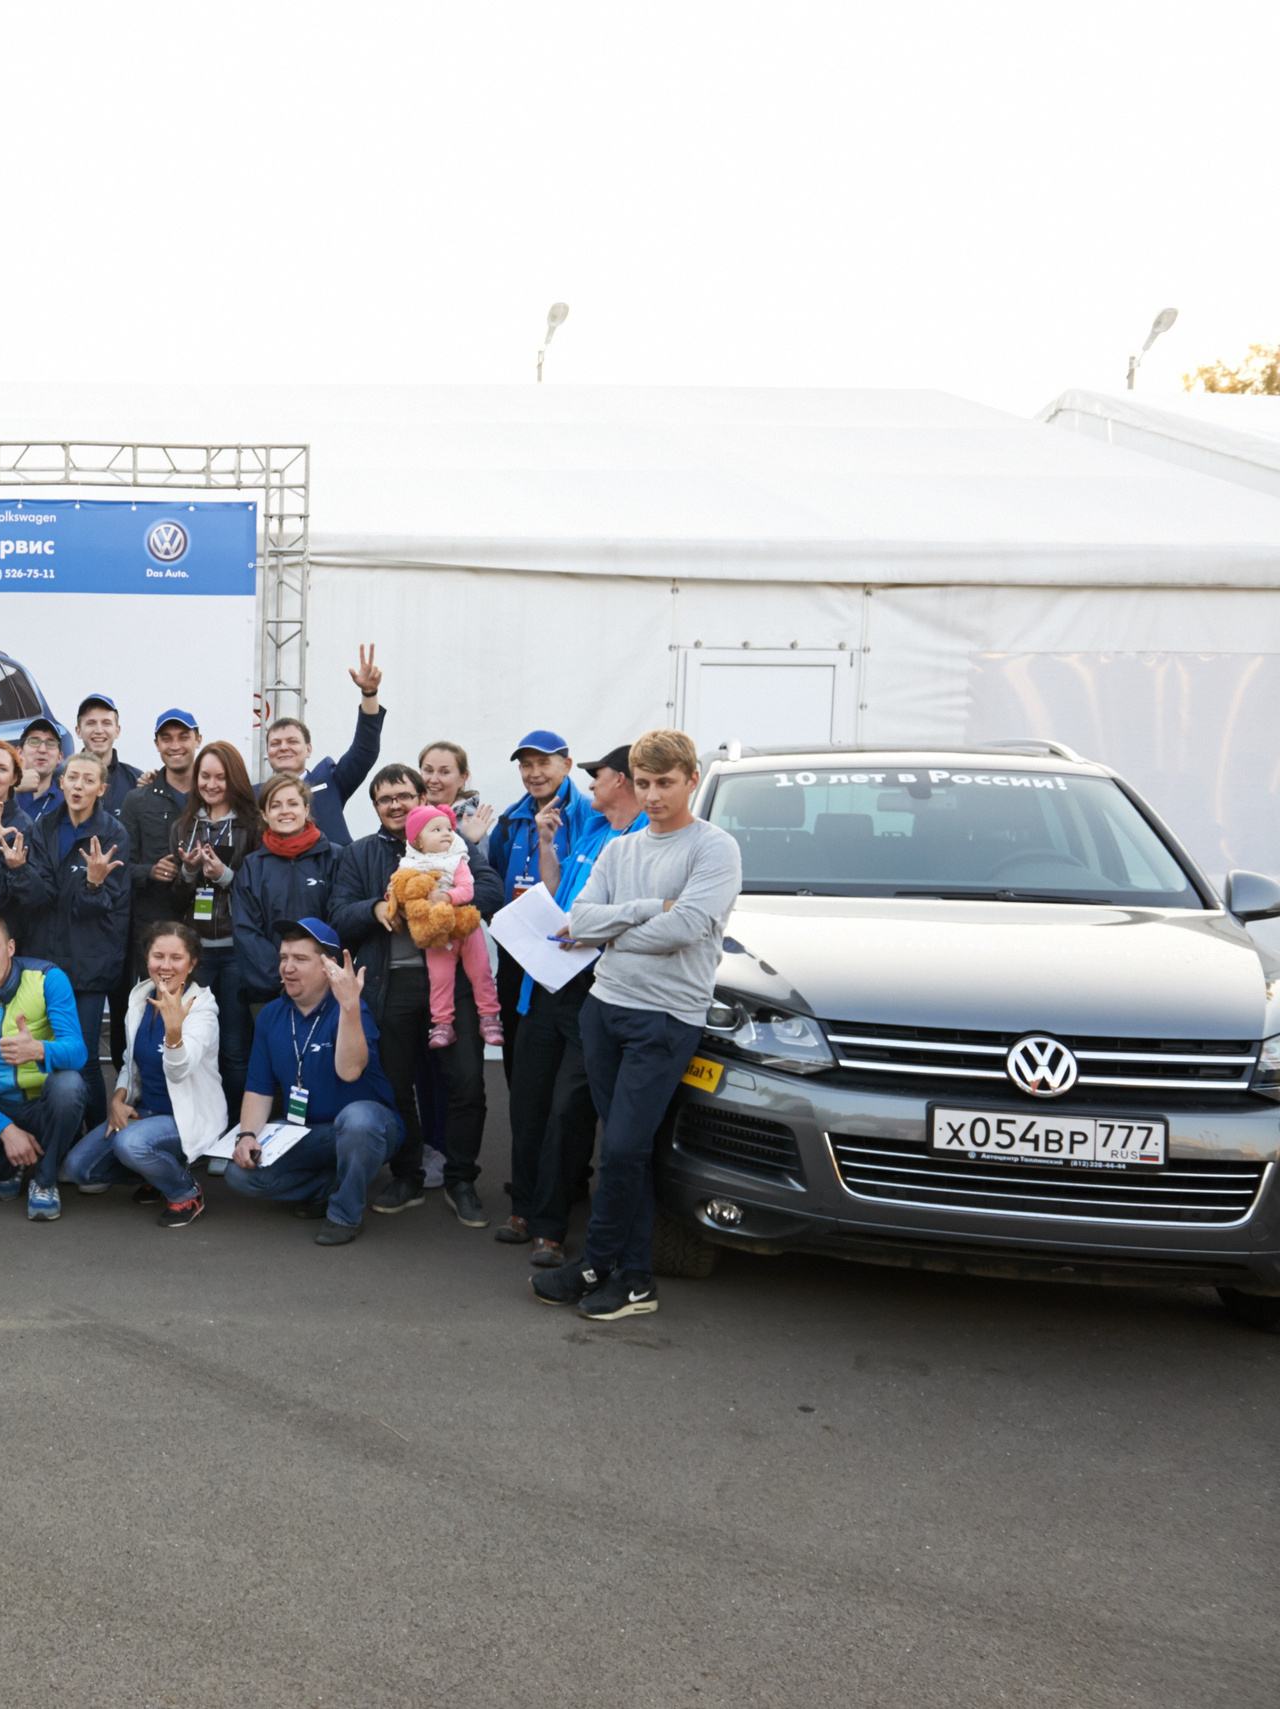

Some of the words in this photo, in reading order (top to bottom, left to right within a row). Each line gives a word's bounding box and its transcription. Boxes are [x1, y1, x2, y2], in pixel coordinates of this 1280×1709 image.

[5, 569, 55, 579] 526-75-11
[146, 568, 163, 577] Das
[165, 569, 189, 578] Auto.
[774, 772, 817, 788] 10
[828, 773, 886, 785] лет
[898, 773, 917, 783] в
[928, 769, 1069, 791] России!
[1099, 1123, 1153, 1150] 777
[1111, 1150, 1138, 1160] RUS
